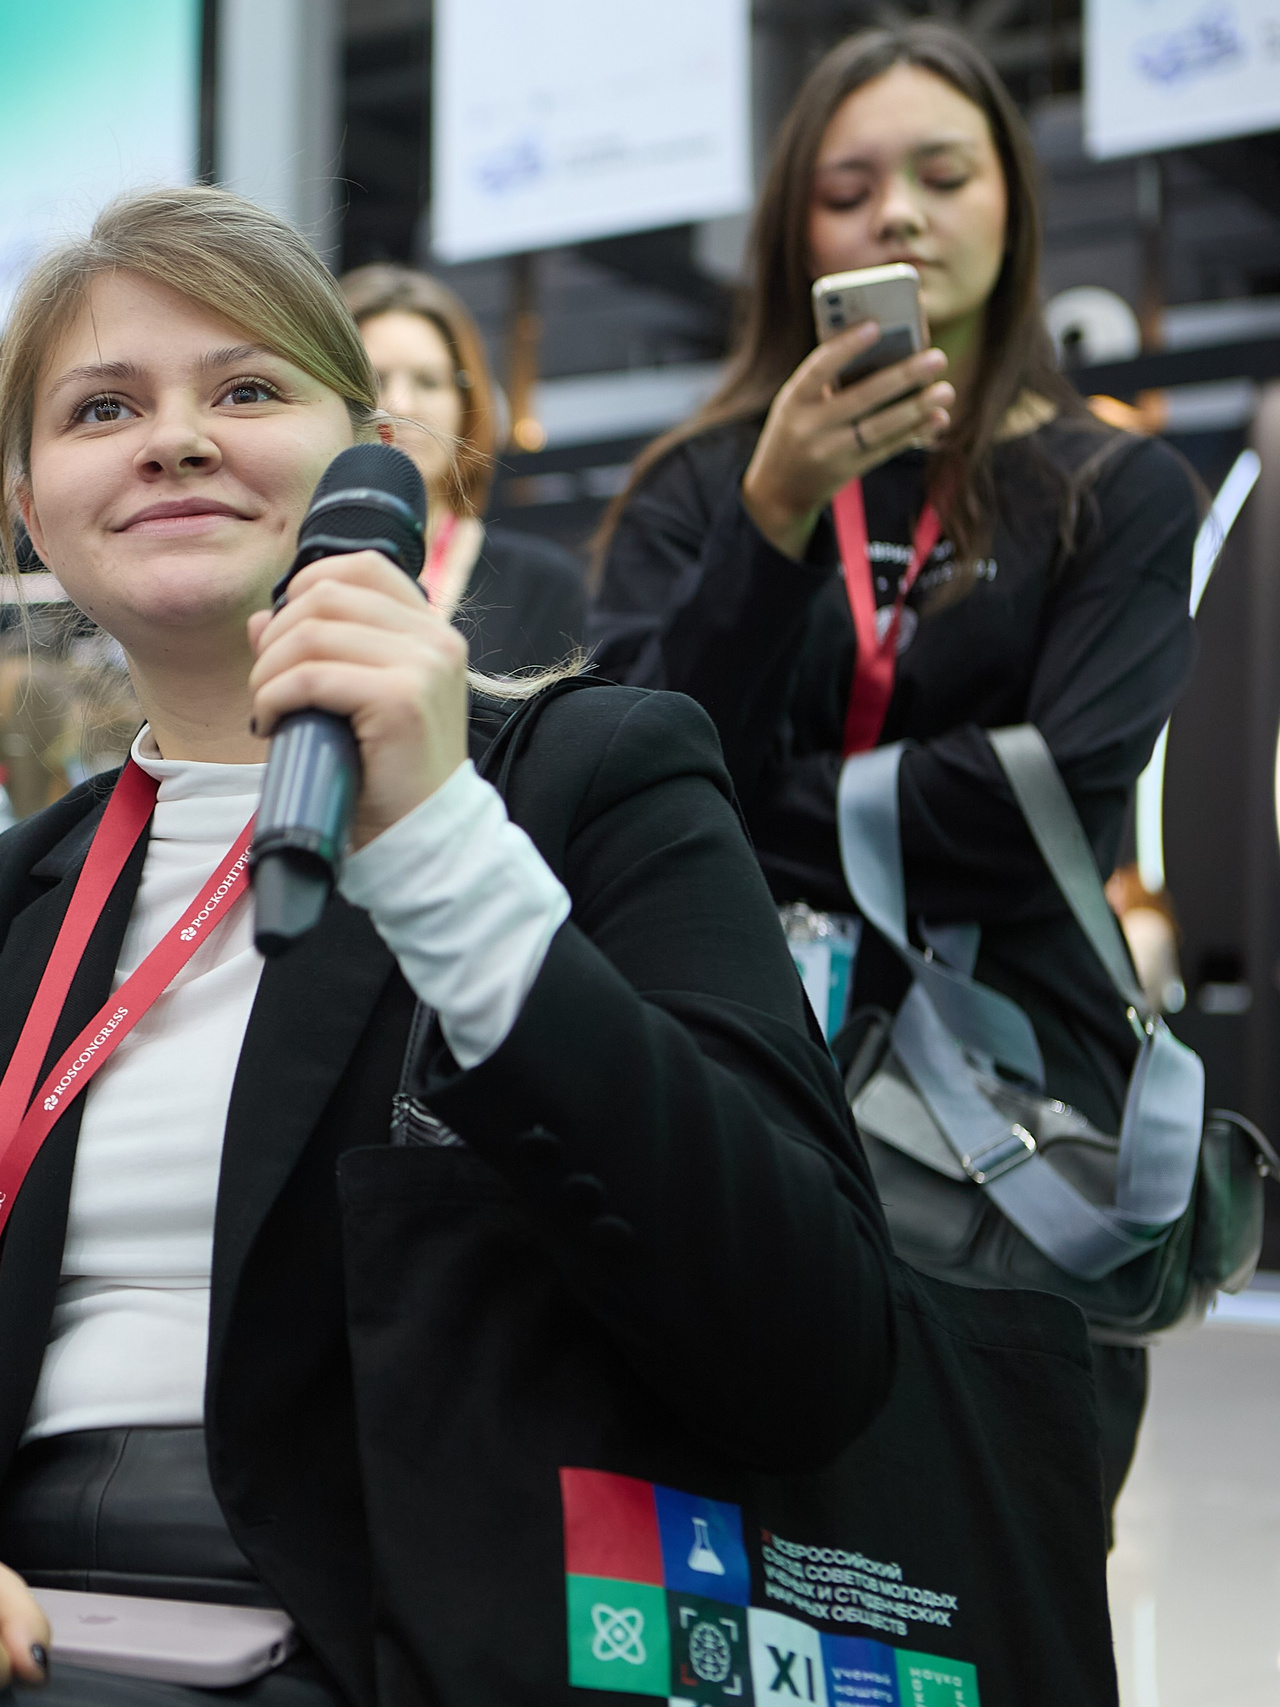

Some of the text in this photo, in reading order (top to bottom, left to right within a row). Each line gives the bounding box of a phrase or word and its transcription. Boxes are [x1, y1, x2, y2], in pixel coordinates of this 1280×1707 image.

[191, 844, 254, 928] РОСКОНГРЕС
[53, 1006, 129, 1095] ROSCONGRESS
[765, 1644, 816, 1703] XI
